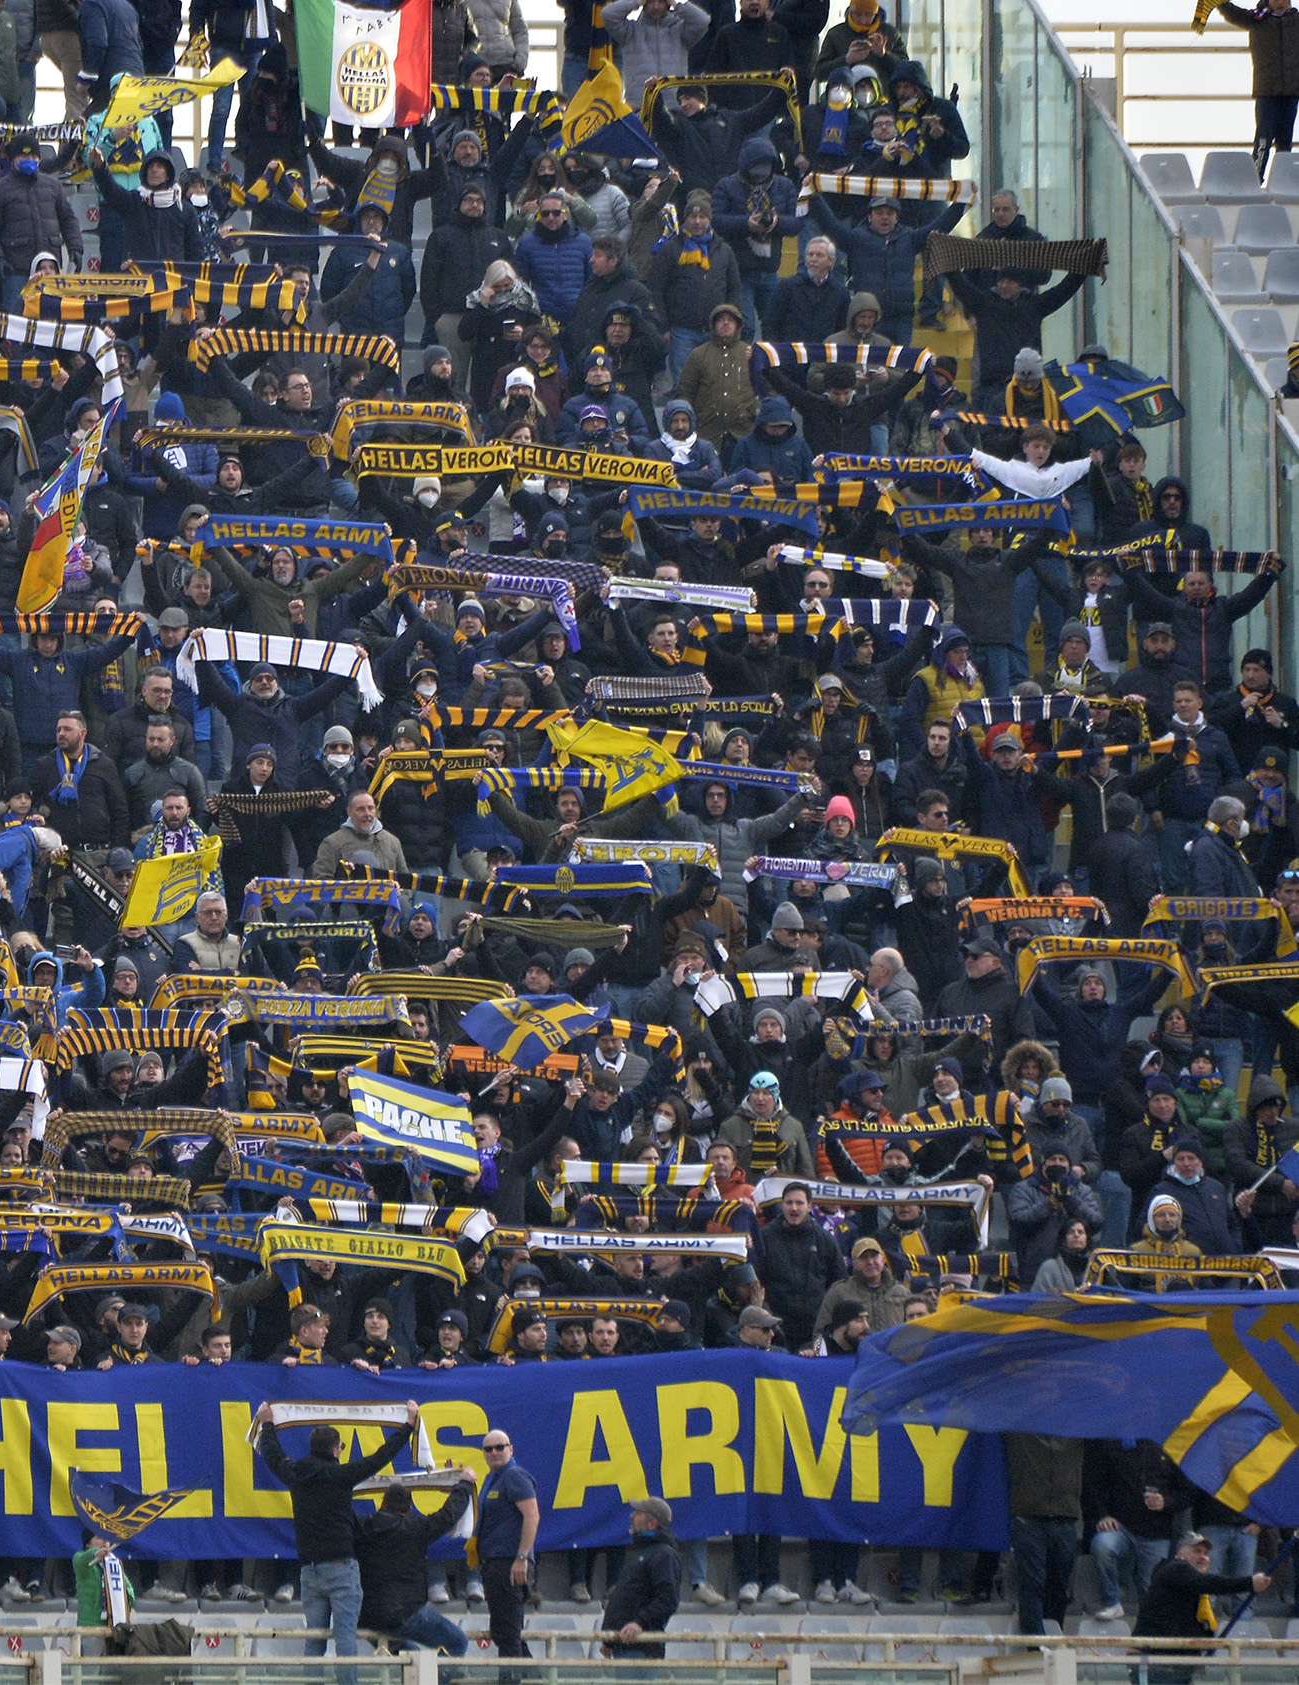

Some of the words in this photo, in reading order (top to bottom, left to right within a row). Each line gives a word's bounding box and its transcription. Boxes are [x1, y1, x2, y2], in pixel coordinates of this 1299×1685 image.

[340, 75, 388, 85] VERONA
[343, 67, 385, 77] HELLAS
[420, 405, 464, 423] ARM
[362, 448, 439, 470] HELLAS
[446, 447, 511, 469] VERON
[511, 445, 580, 473] HELLAS
[586, 457, 658, 481] VERONA
[895, 457, 971, 476] VERONA
[637, 493, 731, 512] HELLAS
[738, 495, 814, 520] ARMY
[900, 505, 975, 528] ELLAS
[983, 503, 1057, 522] ARMY
[212, 521, 307, 540] HELLAS
[314, 522, 385, 547] ARMY
[895, 832, 938, 846] ELLAS
[764, 856, 821, 873] FIORENTINA
[986, 906, 1053, 922] VERONA
[1173, 900, 1255, 917] BRIGATE
[1028, 939, 1110, 958] HELLAS
[1117, 940, 1179, 959] ARMY
[163, 977, 237, 999] HELLAS
[256, 998, 311, 1017] FORZA
[314, 998, 386, 1018] VERONA
[252, 1117, 315, 1135] ARMY
[364, 1093, 465, 1145] PACHE
[310, 1177, 366, 1201] ARM
[808, 1182, 896, 1201] HELLAS
[907, 1185, 977, 1201] ARMY
[130, 1217, 187, 1236] ARMY
[269, 1233, 335, 1253] BRIGATE
[348, 1239, 404, 1257] GIALLO
[416, 1245, 445, 1262] BLU
[543, 1233, 636, 1248] HELLAS
[646, 1236, 716, 1248] ARMY
[51, 1268, 134, 1287] HELLAS
[142, 1268, 206, 1284] ARMY
[608, 1301, 661, 1321] ARM
[553, 1377, 968, 1510] ARMY
